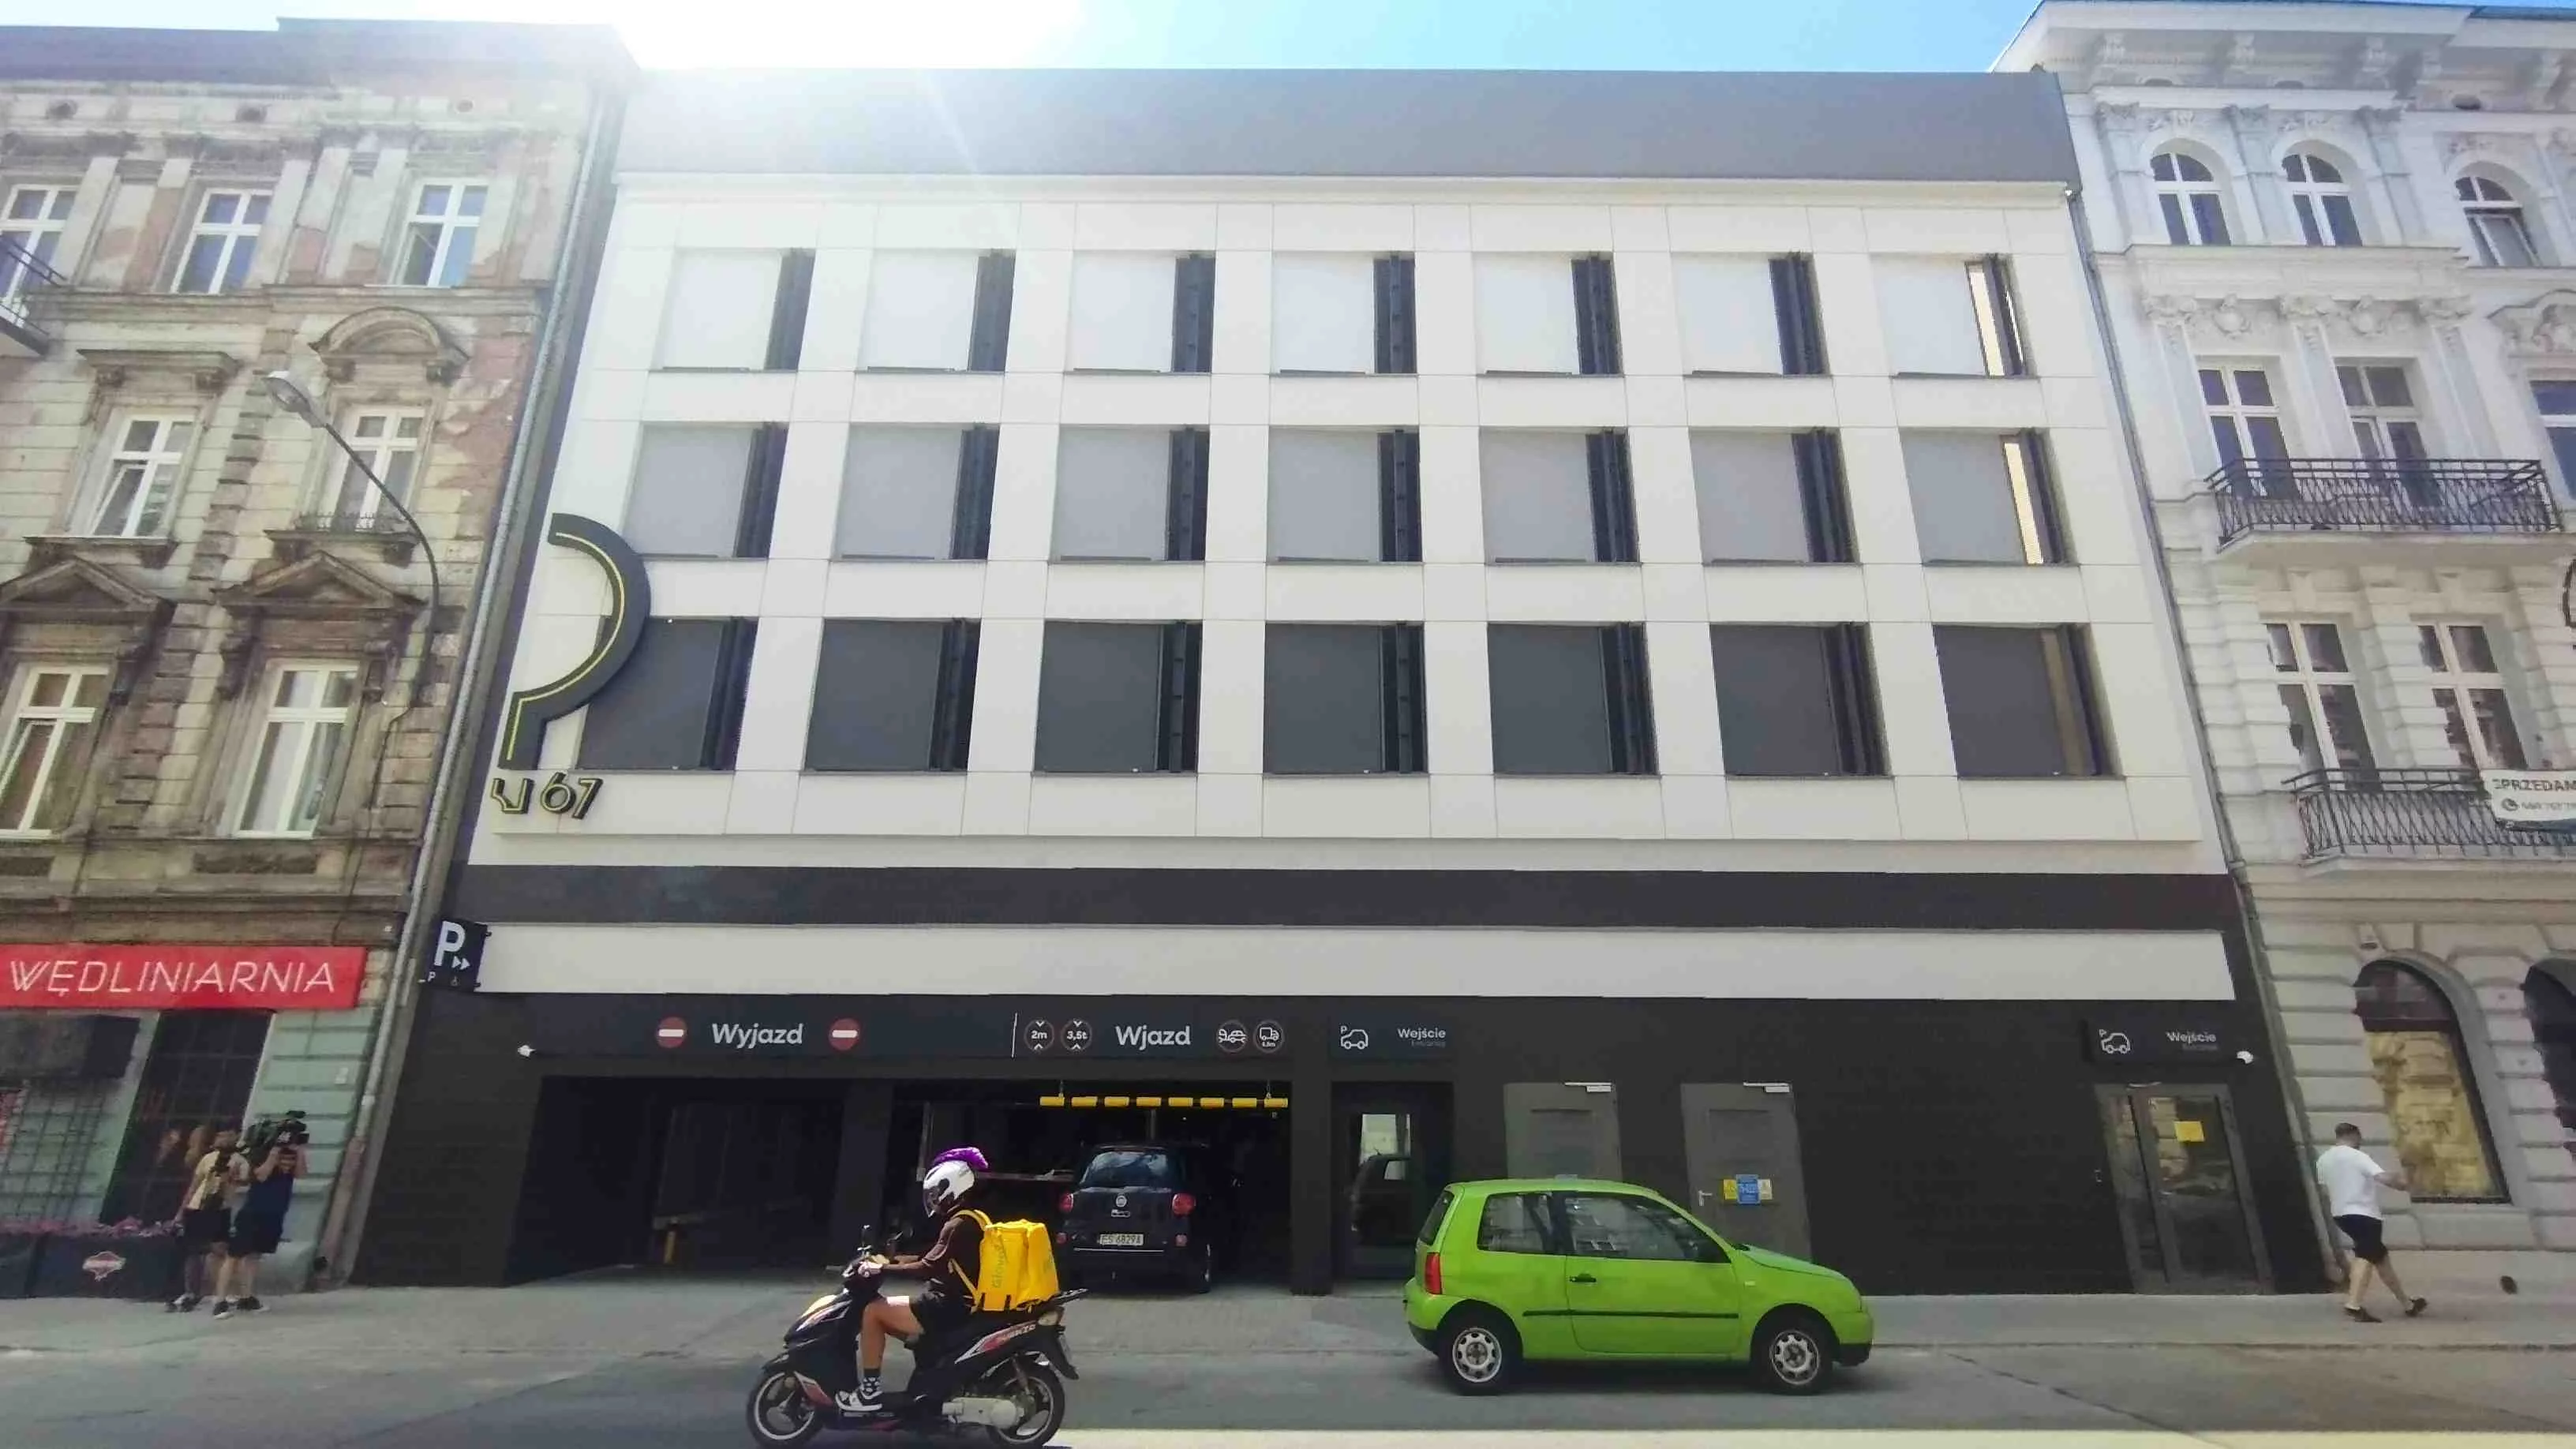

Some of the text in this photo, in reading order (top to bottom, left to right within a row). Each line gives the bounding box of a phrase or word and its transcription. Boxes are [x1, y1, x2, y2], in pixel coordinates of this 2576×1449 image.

[434, 920, 466, 967] P
[10, 960, 335, 997] WĘDLINIARNIA
[712, 1023, 803, 1049] Wyjazd
[1031, 1030, 1048, 1039] 2m
[1115, 1024, 1191, 1050] Wjazd
[1397, 1027, 1446, 1040] Wejście
